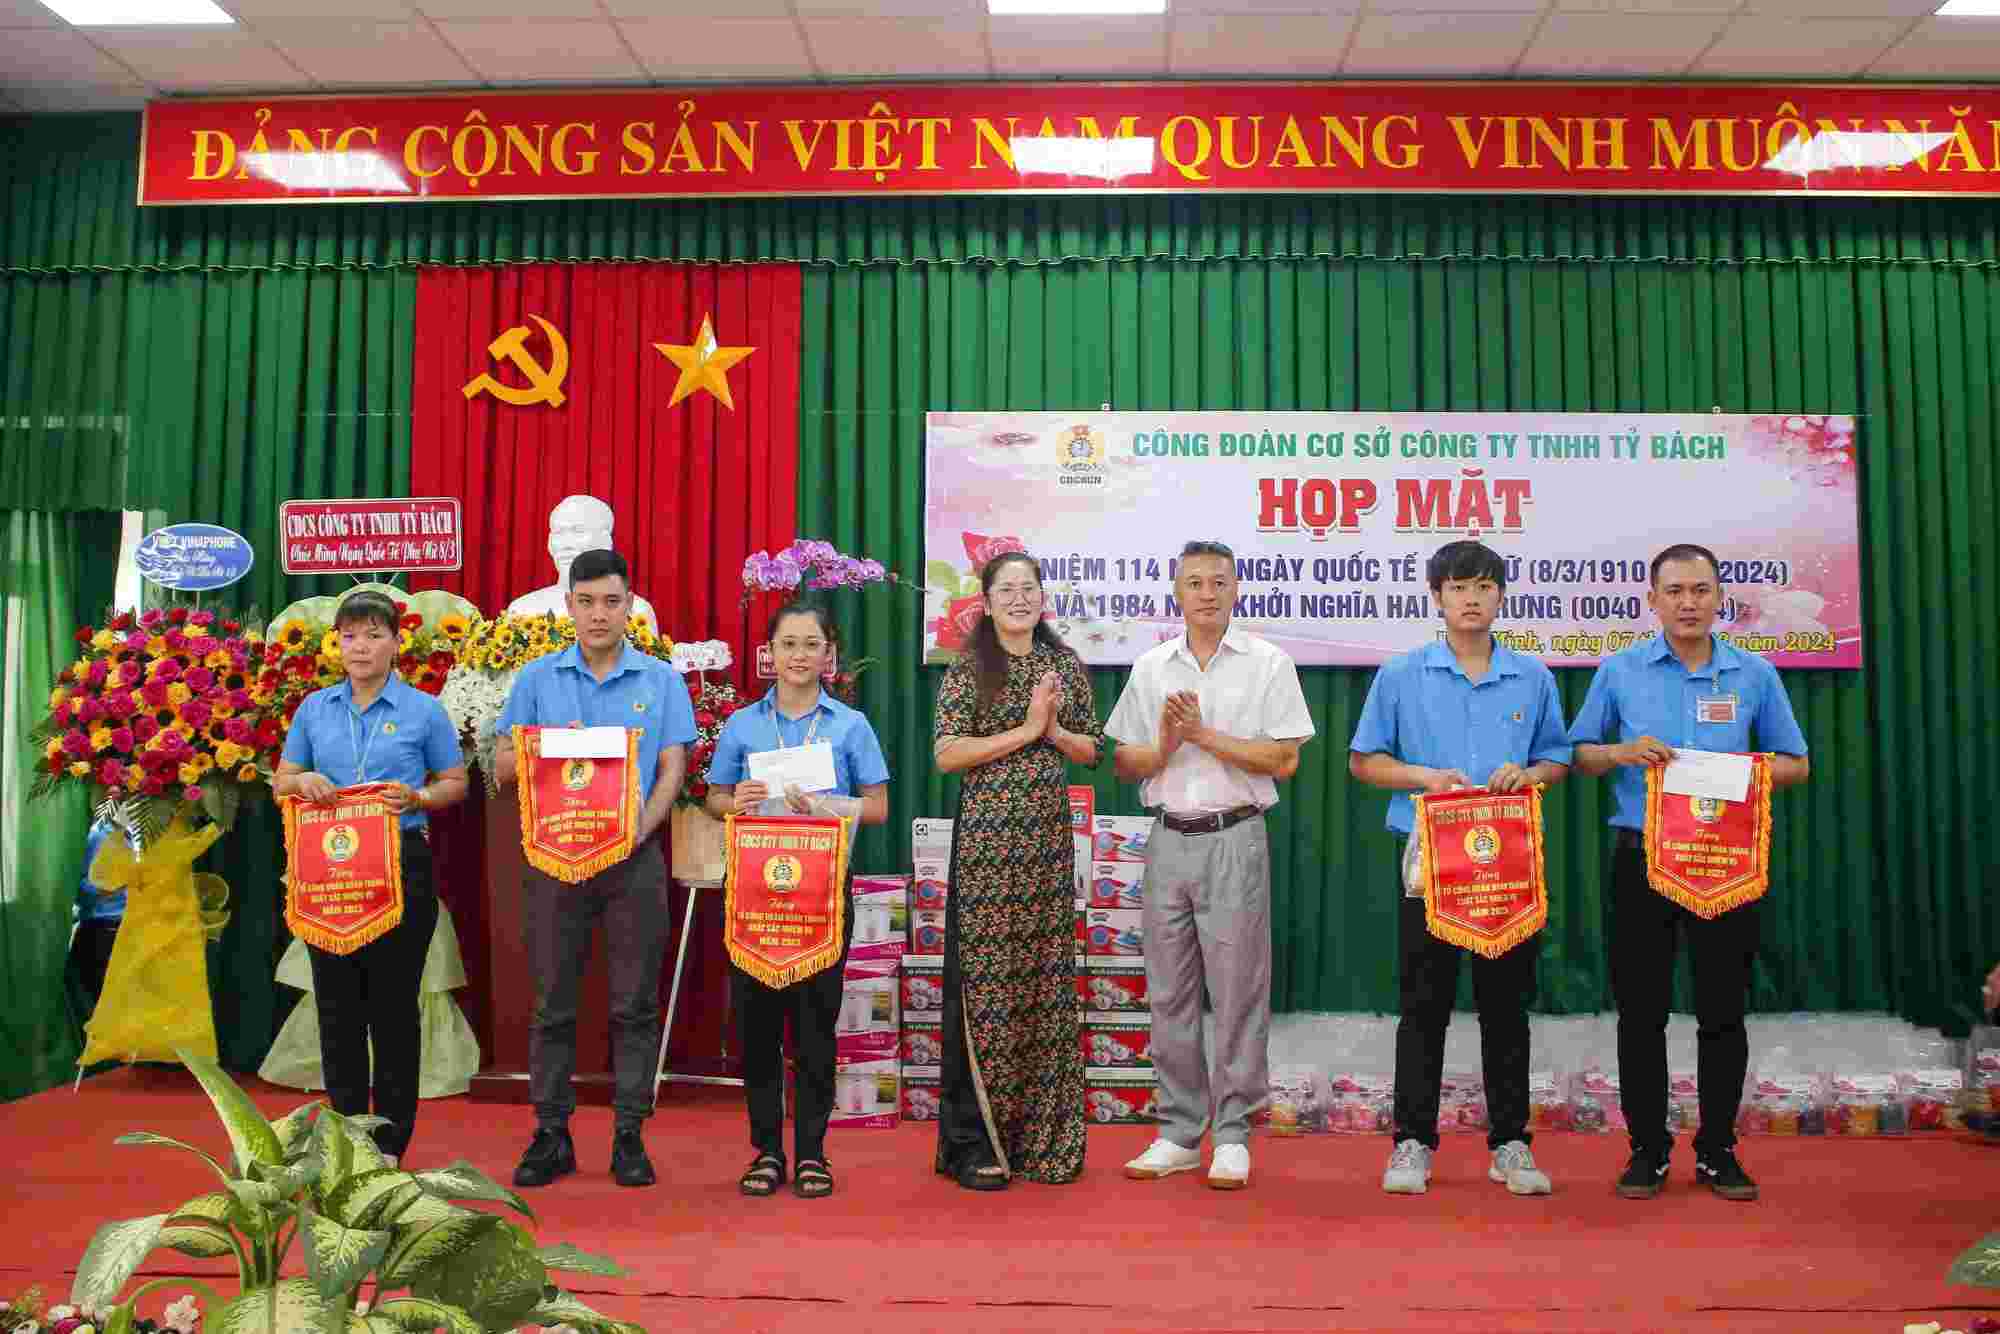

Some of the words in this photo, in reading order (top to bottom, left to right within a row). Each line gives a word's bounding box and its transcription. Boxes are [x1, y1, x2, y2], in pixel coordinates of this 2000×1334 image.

[403, 108, 600, 187] CỘNG
[619, 100, 760, 176] SẢN
[782, 102, 951, 182] VIỆT
[1161, 115, 1425, 180] QUANG
[1446, 116, 1630, 172] VINH
[1132, 428, 1210, 457] CÔNG
[1218, 427, 1297, 457] ĐOÀN
[1306, 431, 1345, 457] CƠ
[1354, 425, 1391, 457] SỞ
[1400, 428, 1478, 459] CÔNG
[1487, 433, 1520, 459] TY
[1527, 433, 1600, 460] TNHH
[1610, 426, 1640, 460] TỶ
[1650, 428, 1725, 460] BÁCH
[1257, 477, 1378, 537] HỌP
[1395, 468, 1532, 537] MẶT
[351, 512, 367, 536] TY
[1040, 553, 1106, 587] NIỆM
[1115, 557, 1160, 581] 114
[1236, 554, 1304, 582] NGÀY
[1312, 551, 1381, 584] QUỐC
[1388, 551, 1419, 582] TẾ
[1503, 555, 1521, 583] Ữ
[1529, 559, 1646, 585] (8/3/1910
[1719, 560, 1788, 585] 2024)
[1054, 590, 1087, 618] VÀ
[1095, 594, 1156, 618] 1984
[1232, 587, 1291, 618] KHỞI
[1300, 590, 1379, 618] NGHĨA
[1386, 595, 1429, 619] HAI
[1571, 595, 1641, 621] (0040
[1784, 630, 1837, 654] 2024
